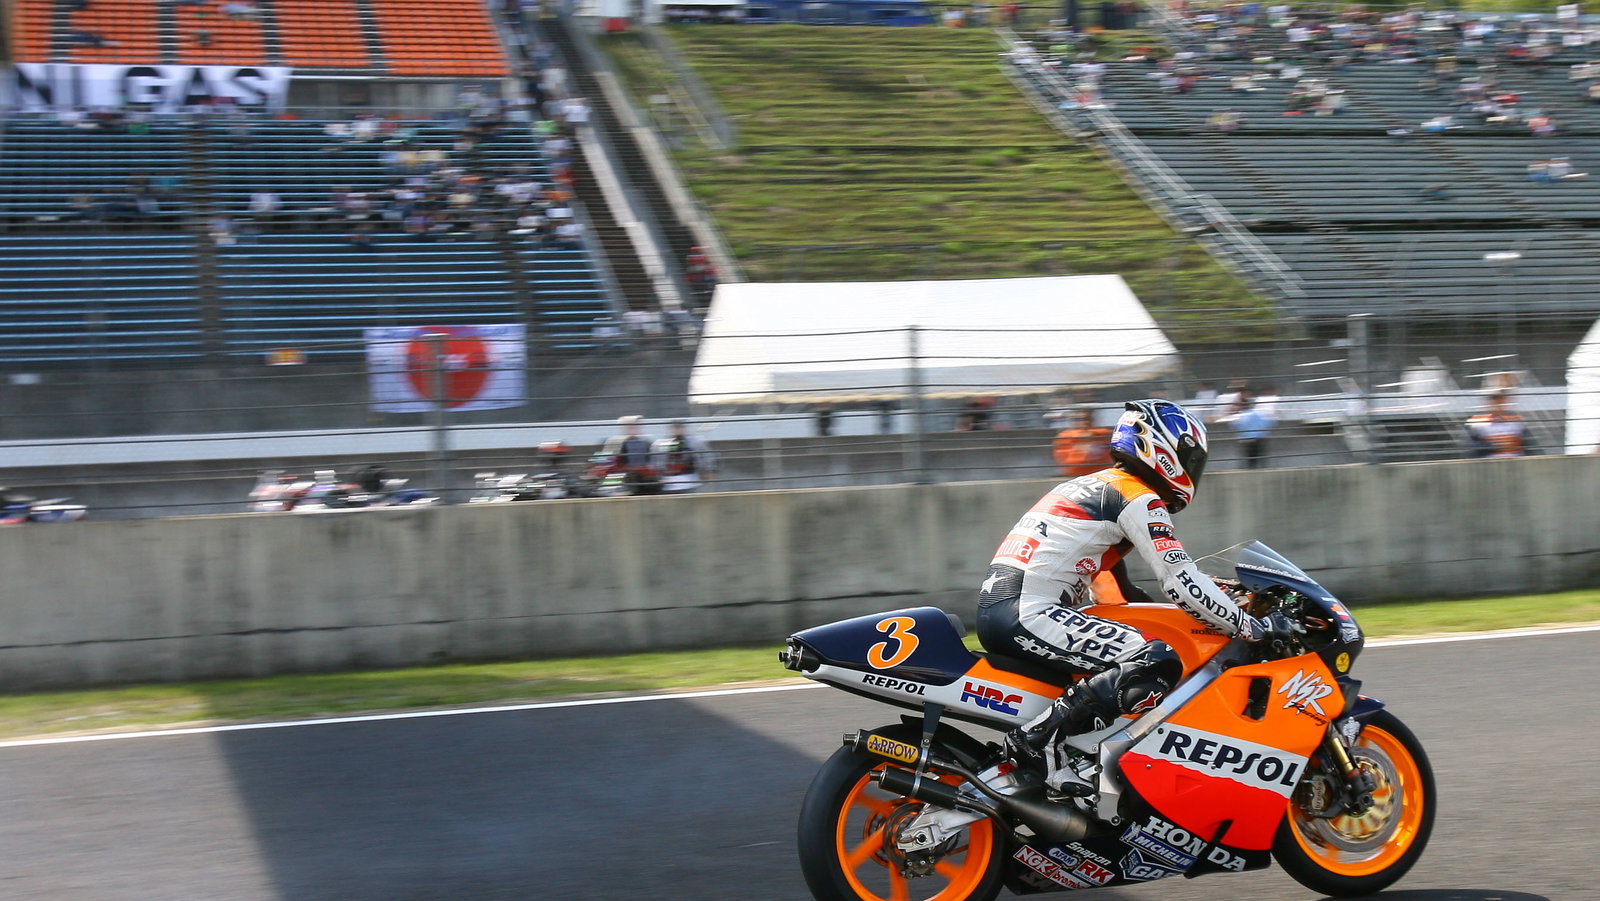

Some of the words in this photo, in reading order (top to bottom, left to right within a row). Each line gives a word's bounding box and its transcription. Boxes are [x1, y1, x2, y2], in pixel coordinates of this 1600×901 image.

[1158, 455, 1176, 477] SHOEI
[1176, 570, 1240, 630] HONDA
[867, 616, 920, 670] 3
[1065, 632, 1122, 660] YPF
[862, 674, 925, 695] REPSOL
[960, 681, 1023, 716] HRC
[1277, 669, 1333, 716] NSR
[869, 736, 917, 760] ARROW
[1159, 730, 1299, 787] REPSOL
[1052, 849, 1076, 867] AFAM
[1066, 841, 1112, 866] Snap-on
[1134, 834, 1193, 867] MICHELIN
[1077, 861, 1112, 884] RK
